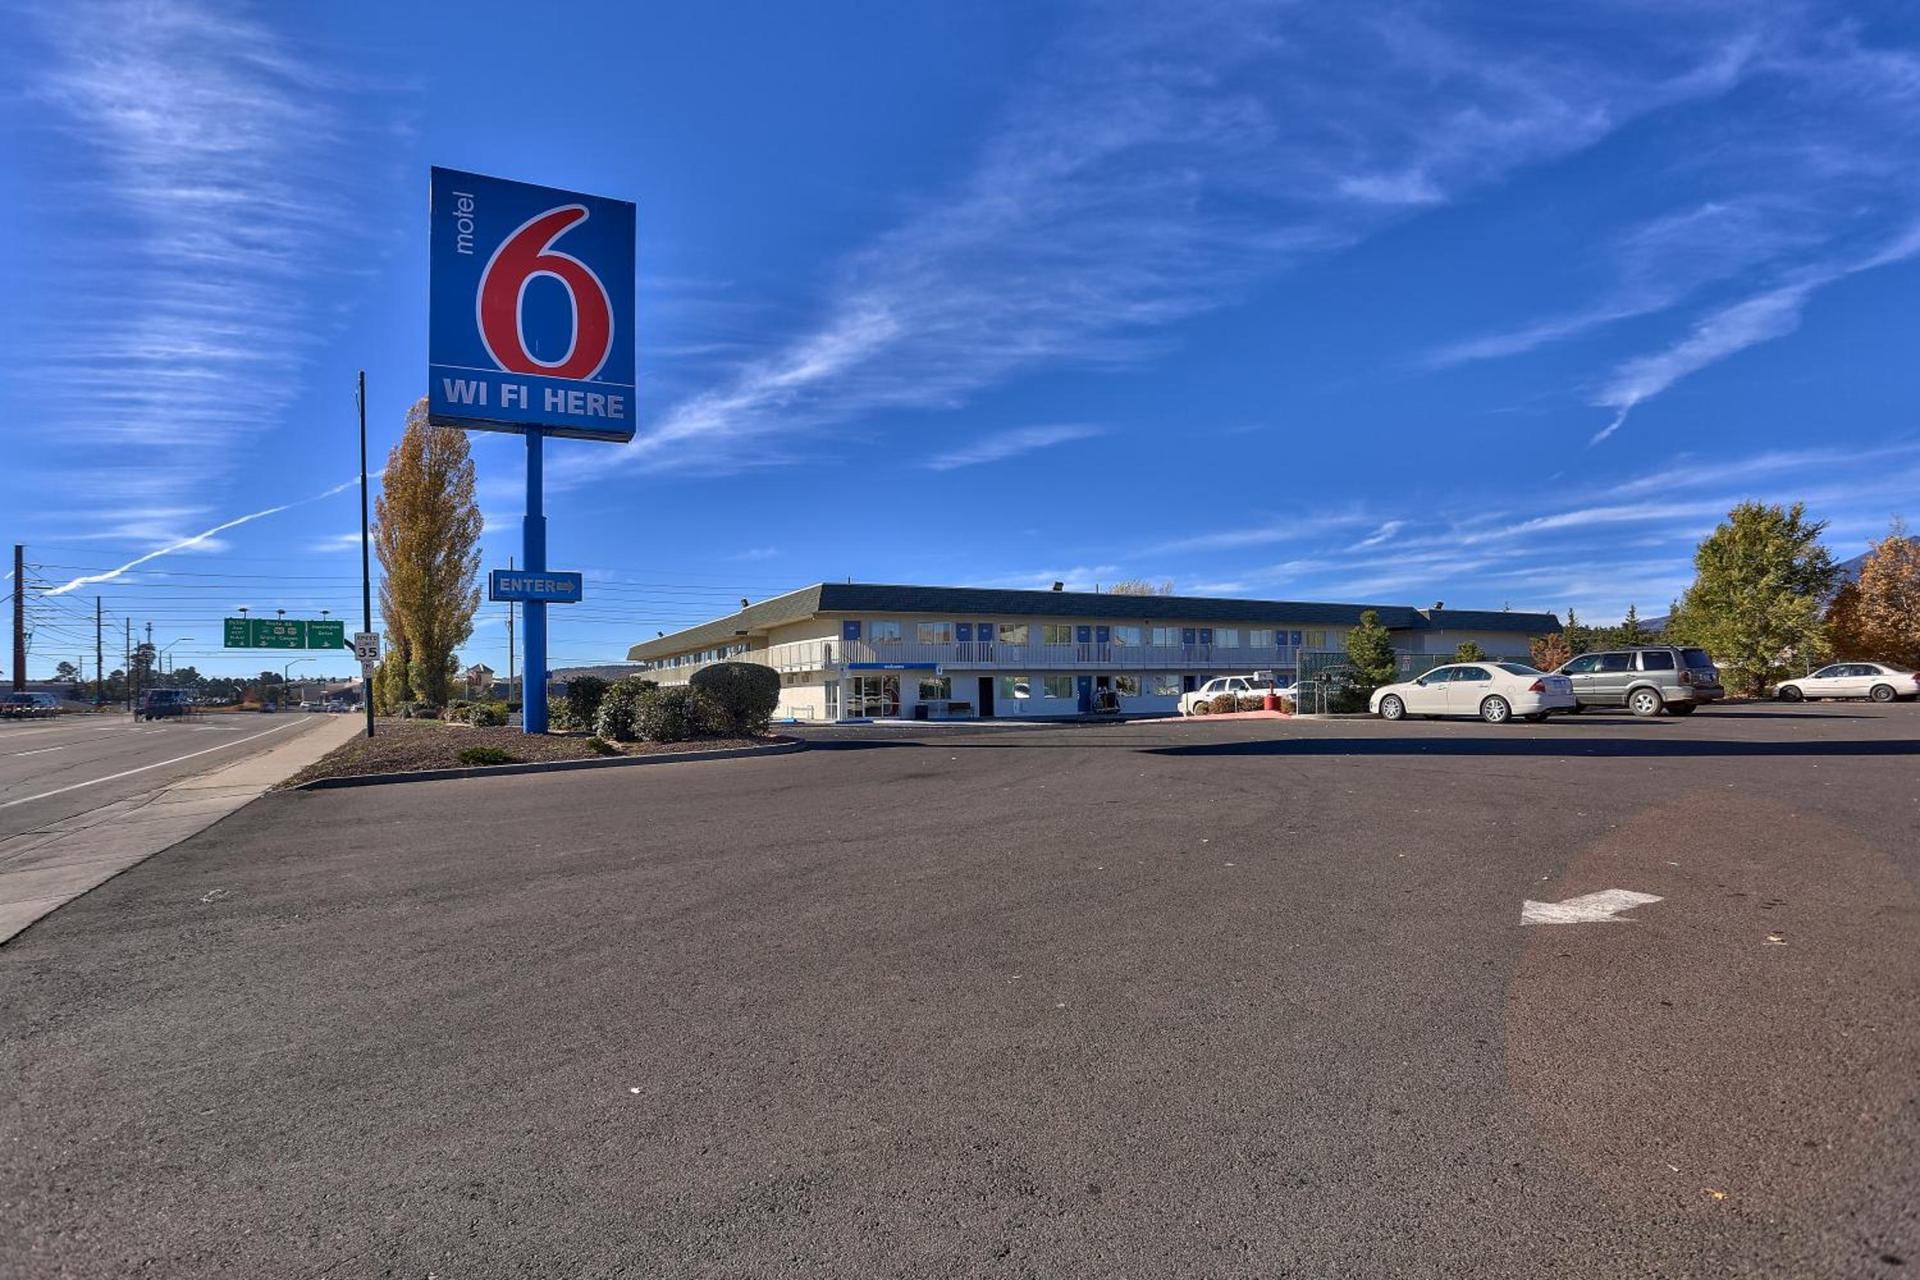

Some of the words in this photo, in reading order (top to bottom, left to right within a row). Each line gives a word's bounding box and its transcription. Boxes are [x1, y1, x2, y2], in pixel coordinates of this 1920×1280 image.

[452, 191, 475, 255] motel
[475, 203, 615, 381] 6
[443, 378, 488, 406] WI
[501, 383, 528, 409] FI
[544, 388, 624, 419] HERE
[500, 578, 556, 593] ENTER
[358, 647, 377, 658] 35
